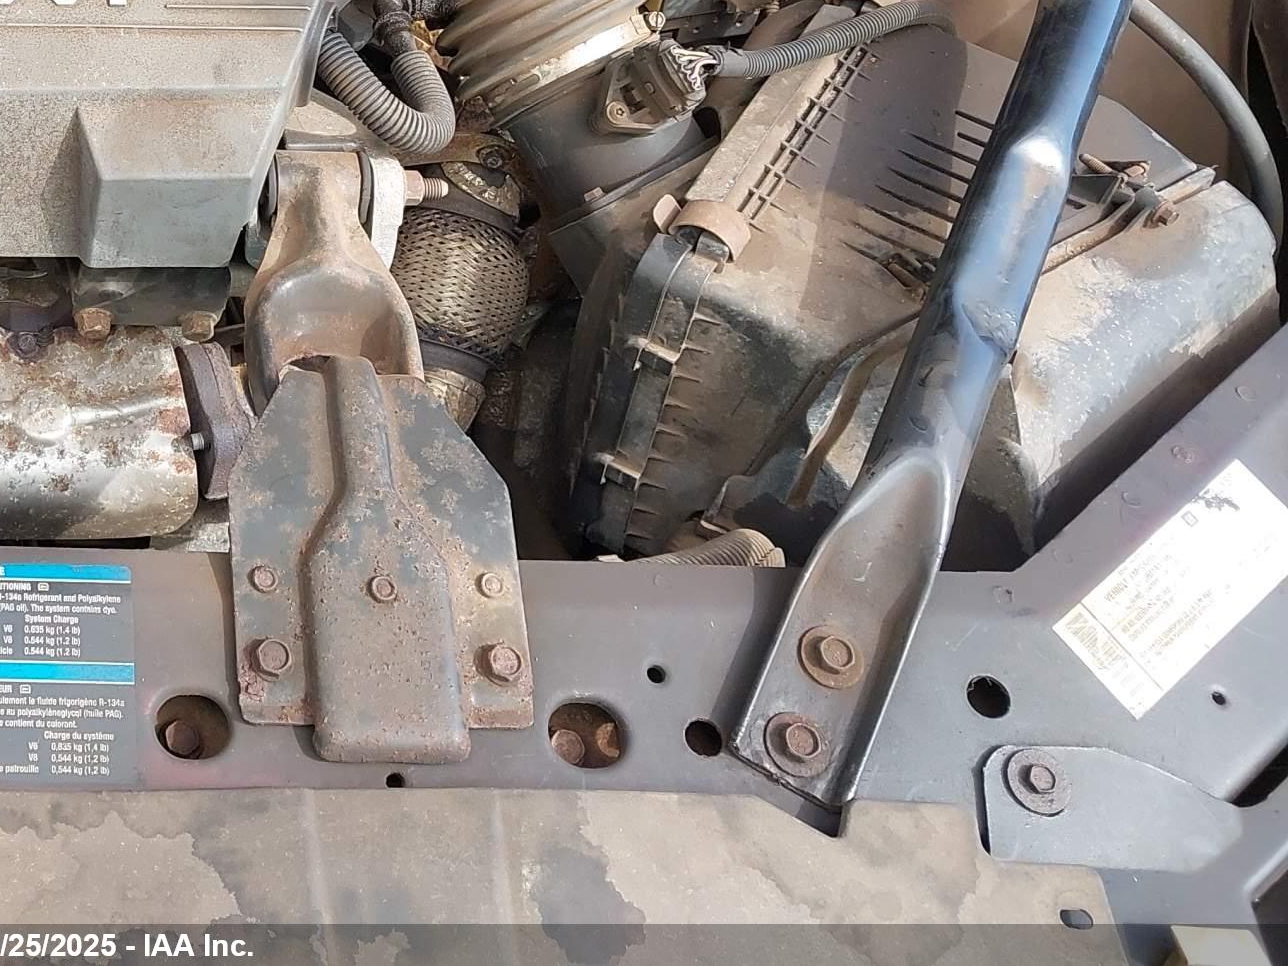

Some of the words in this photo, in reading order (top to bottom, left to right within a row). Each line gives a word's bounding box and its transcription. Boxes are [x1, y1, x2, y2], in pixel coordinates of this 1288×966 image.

[24, 595, 62, 603] Refrigerant
[31, 604, 43, 612] The
[25, 615, 51, 624] System
[53, 615, 78, 624] Charge
[46, 626, 54, 635] kg
[57, 626, 69, 635] (1.4
[72, 626, 80, 635] lb)
[46, 637, 54, 646] kg
[57, 637, 69, 646] (1.2
[72, 637, 80, 645] lb)
[46, 648, 54, 657] kg
[57, 648, 69, 657] (1.2
[72, 648, 80, 657] lb)
[37, 697, 56, 705] fluide
[5, 719, 33, 727] contient
[44, 731, 70, 740] Charge
[73, 732, 82, 740] du
[84, 732, 114, 741] système
[74, 743, 82, 752] kg
[100, 743, 109, 752] lb)
[74, 755, 82, 764] kg
[100, 755, 109, 764] lb)
[6, 764, 39, 773] patrouille
[74, 767, 82, 775] kg
[100, 766, 109, 775] lb)
